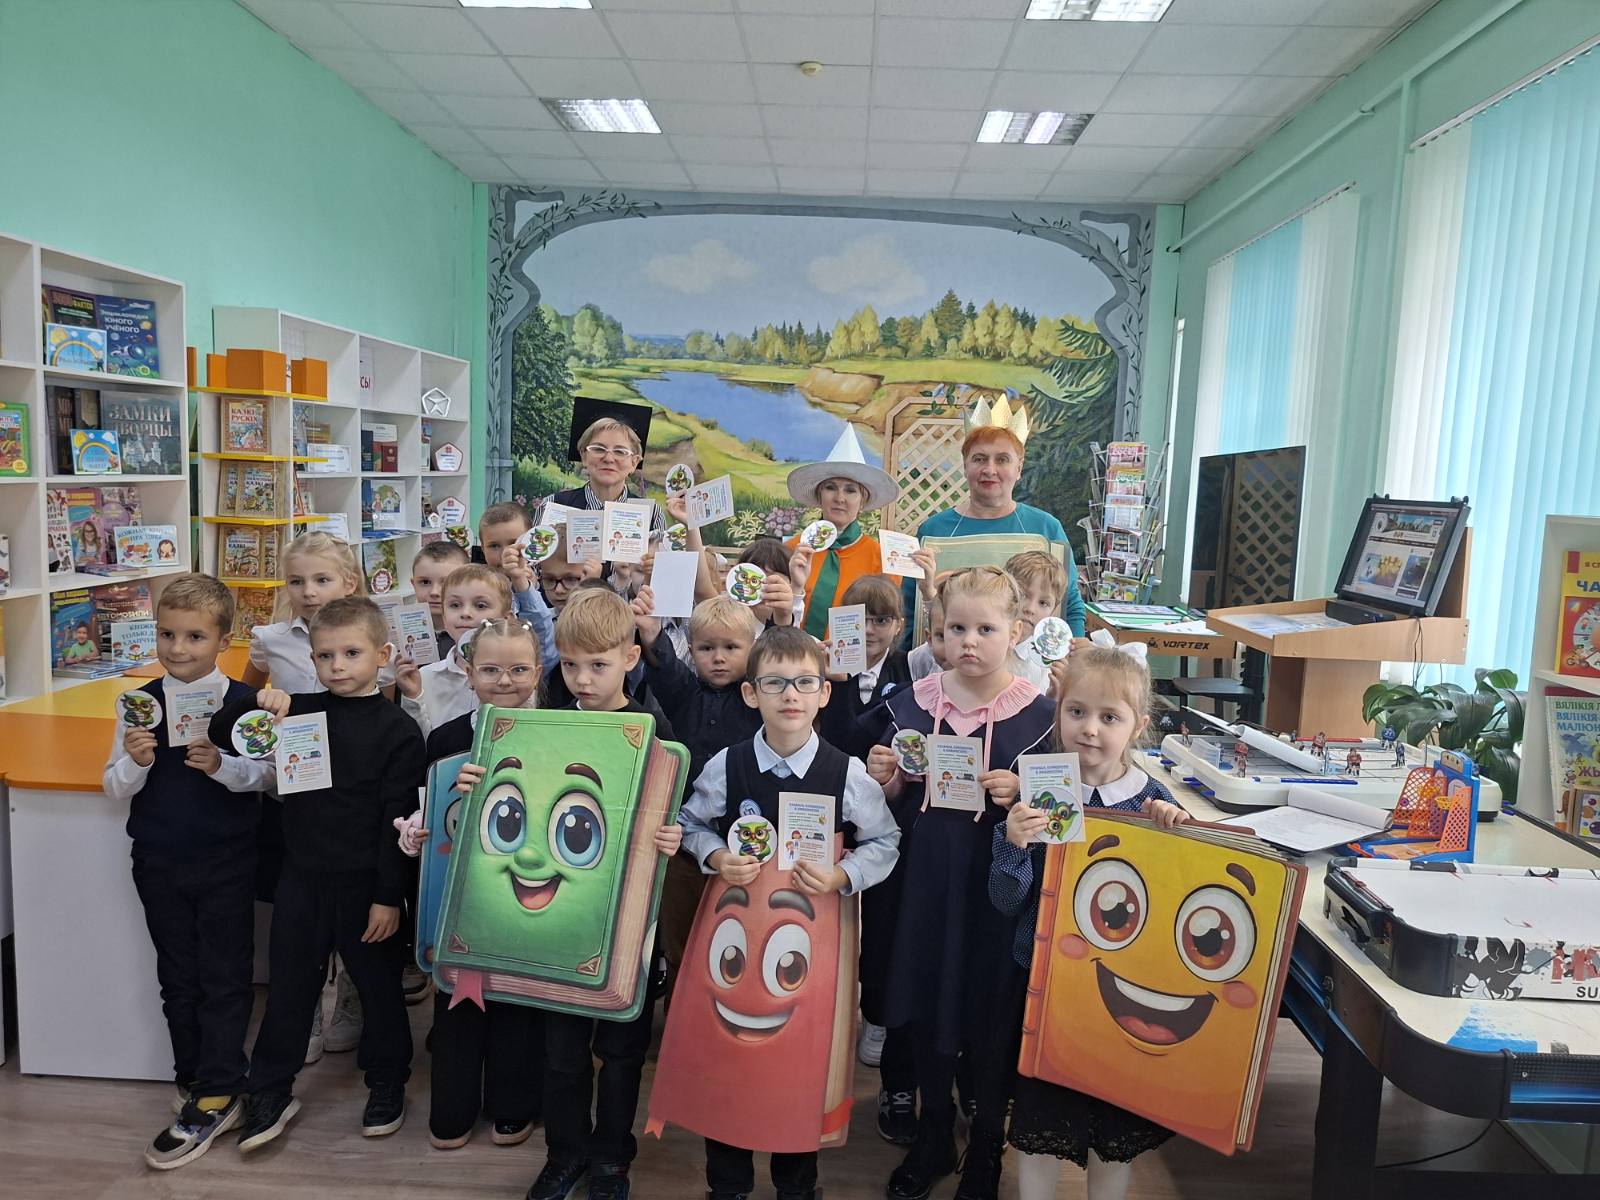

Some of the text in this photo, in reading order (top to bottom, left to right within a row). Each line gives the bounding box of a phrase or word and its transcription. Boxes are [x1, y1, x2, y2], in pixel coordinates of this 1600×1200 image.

[104, 316, 134, 326] ЮНОГО
[109, 404, 171, 422] ЗАМКИ
[1576, 580, 1600, 593] ЧА
[1556, 721, 1600, 732] МАЛЮН
[1576, 986, 1599, 998] SU
